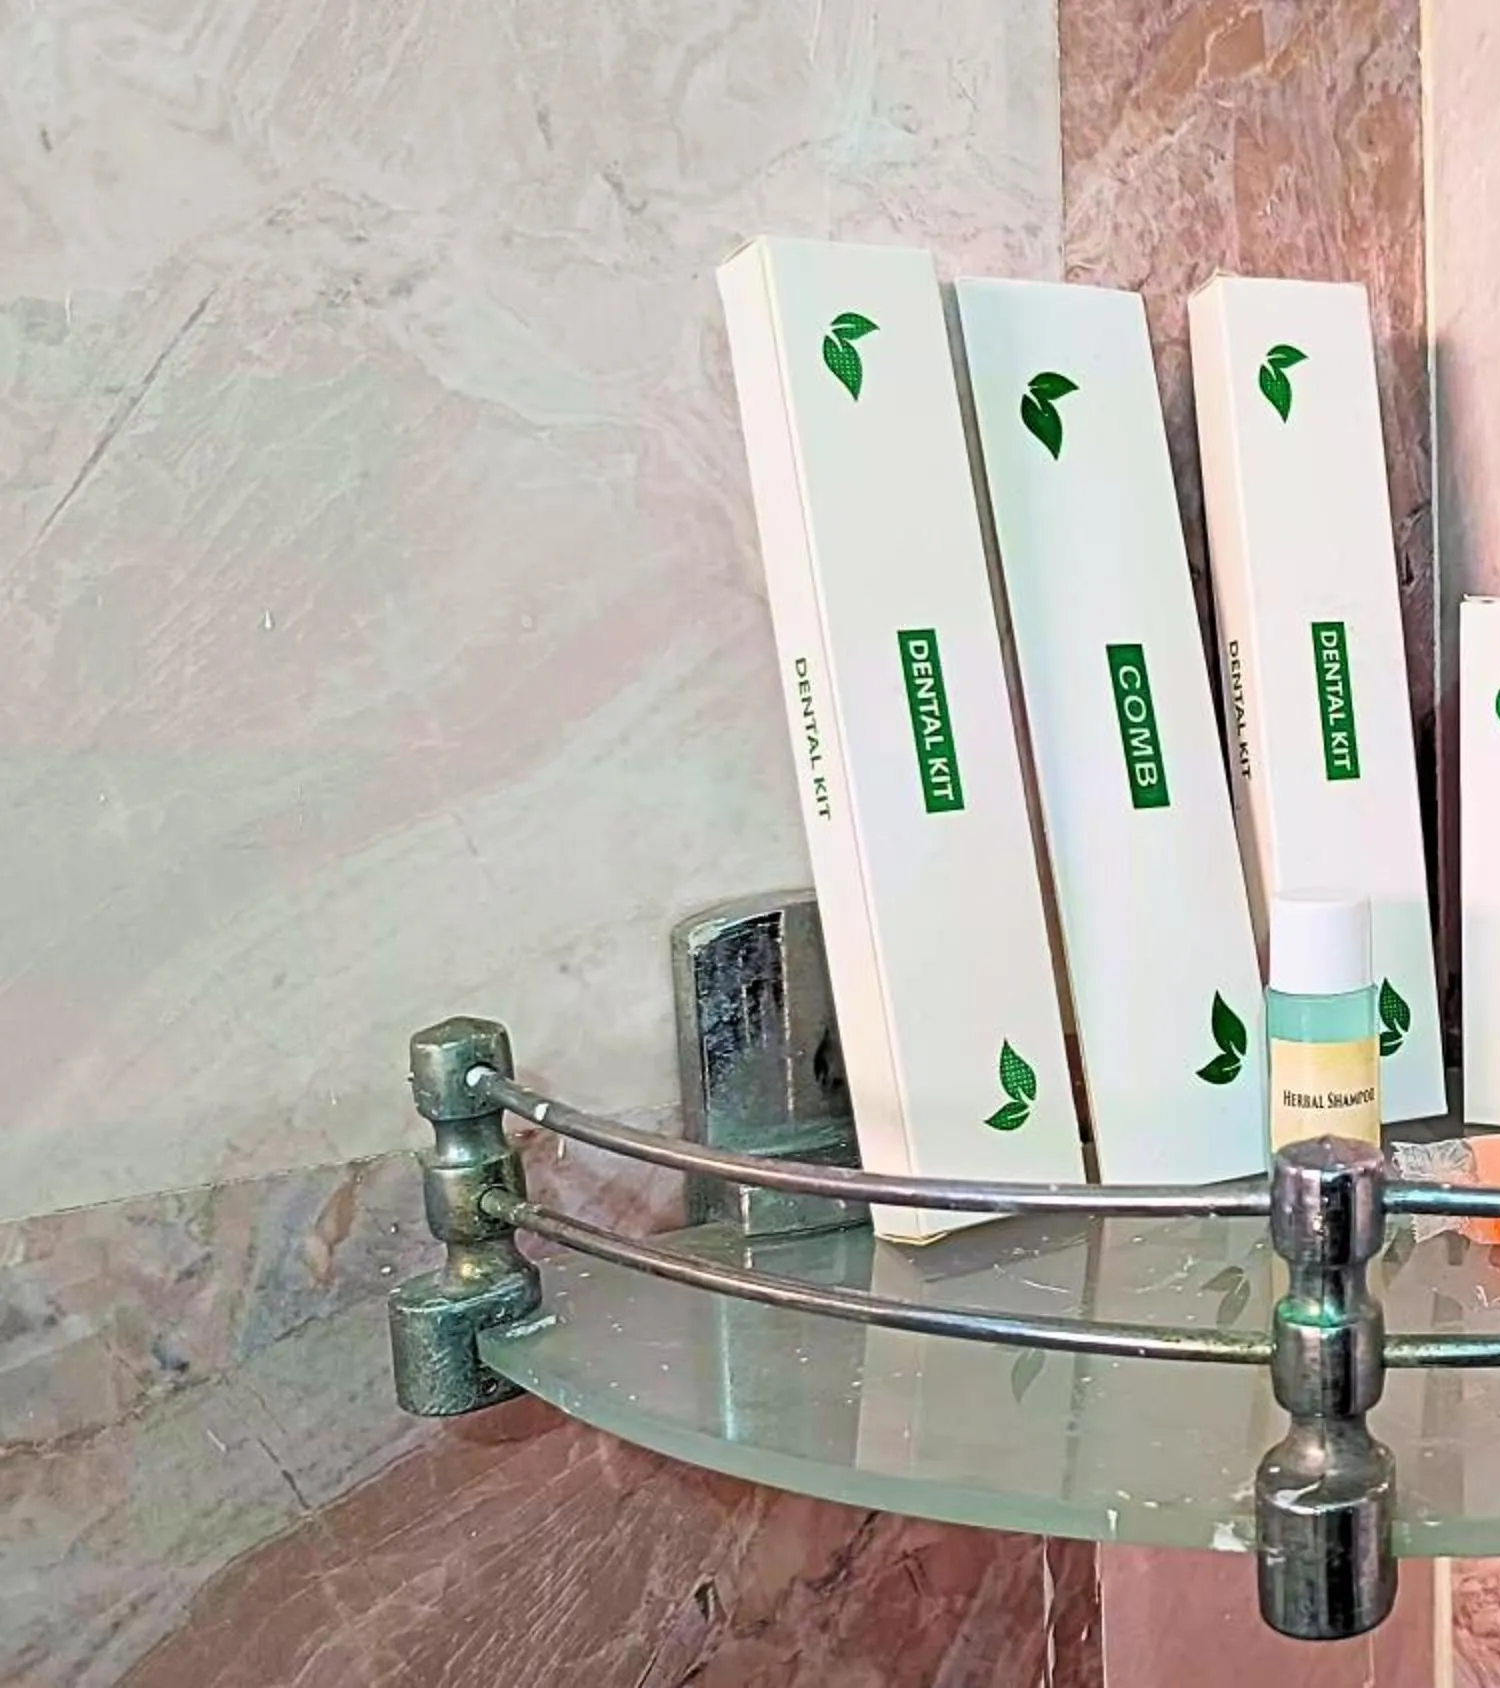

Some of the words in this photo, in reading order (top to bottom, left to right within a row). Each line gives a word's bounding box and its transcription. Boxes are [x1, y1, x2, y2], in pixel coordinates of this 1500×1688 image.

[795, 657, 823, 770] DENTAL
[813, 776, 832, 820] KIT
[908, 638, 946, 751] DENTAL
[928, 757, 954, 801] KIT
[1118, 664, 1157, 789] COMB
[1229, 640, 1247, 737] DENTAL
[1240, 741, 1252, 780] KIT
[1319, 629, 1346, 727] DENTAL
[1330, 731, 1352, 771] KIT
